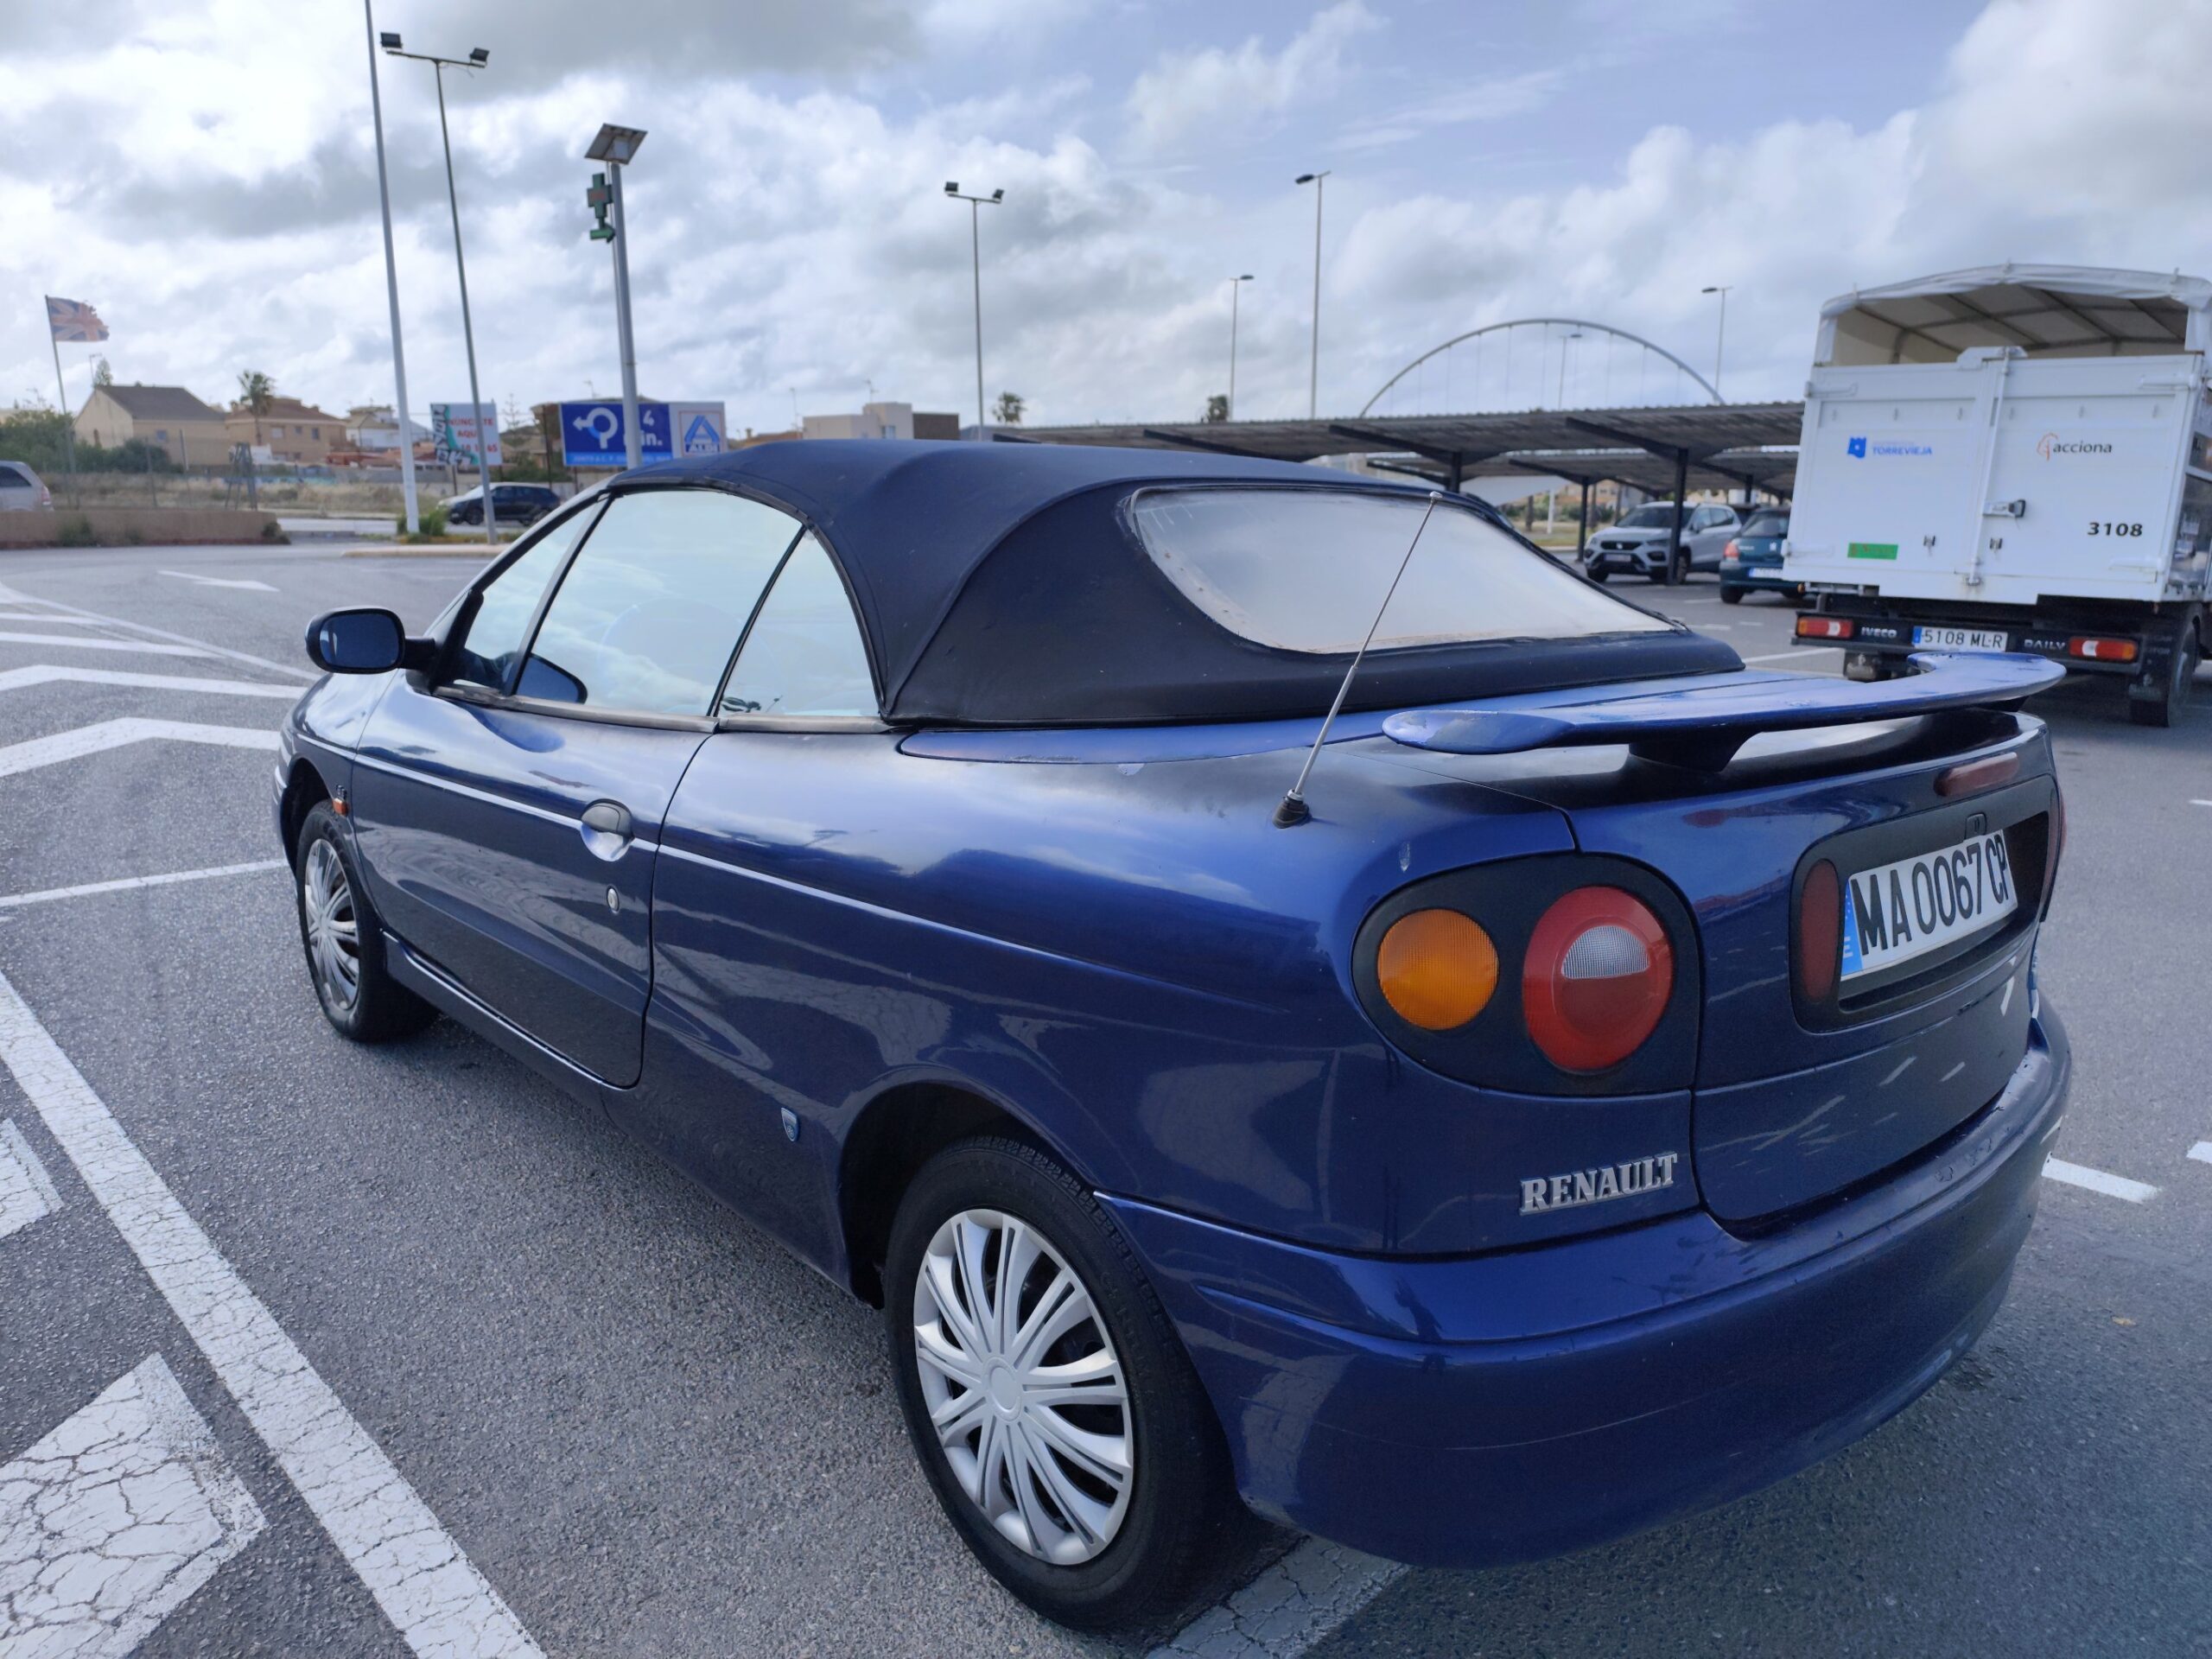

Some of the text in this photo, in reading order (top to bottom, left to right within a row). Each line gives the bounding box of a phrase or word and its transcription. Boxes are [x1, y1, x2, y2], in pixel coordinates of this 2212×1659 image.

[623, 429, 664, 447] in.
[688, 443, 718, 454] ALDI
[1872, 446, 1932, 456] TORREVIEJA
[2052, 440, 2113, 454] acciona
[2087, 521, 2143, 537] 3108
[1861, 626, 1897, 639] IVECO
[1924, 629, 1964, 645] 5108
[2024, 639, 2066, 651] DAILY
[1519, 1151, 1678, 1217] RENAULT
